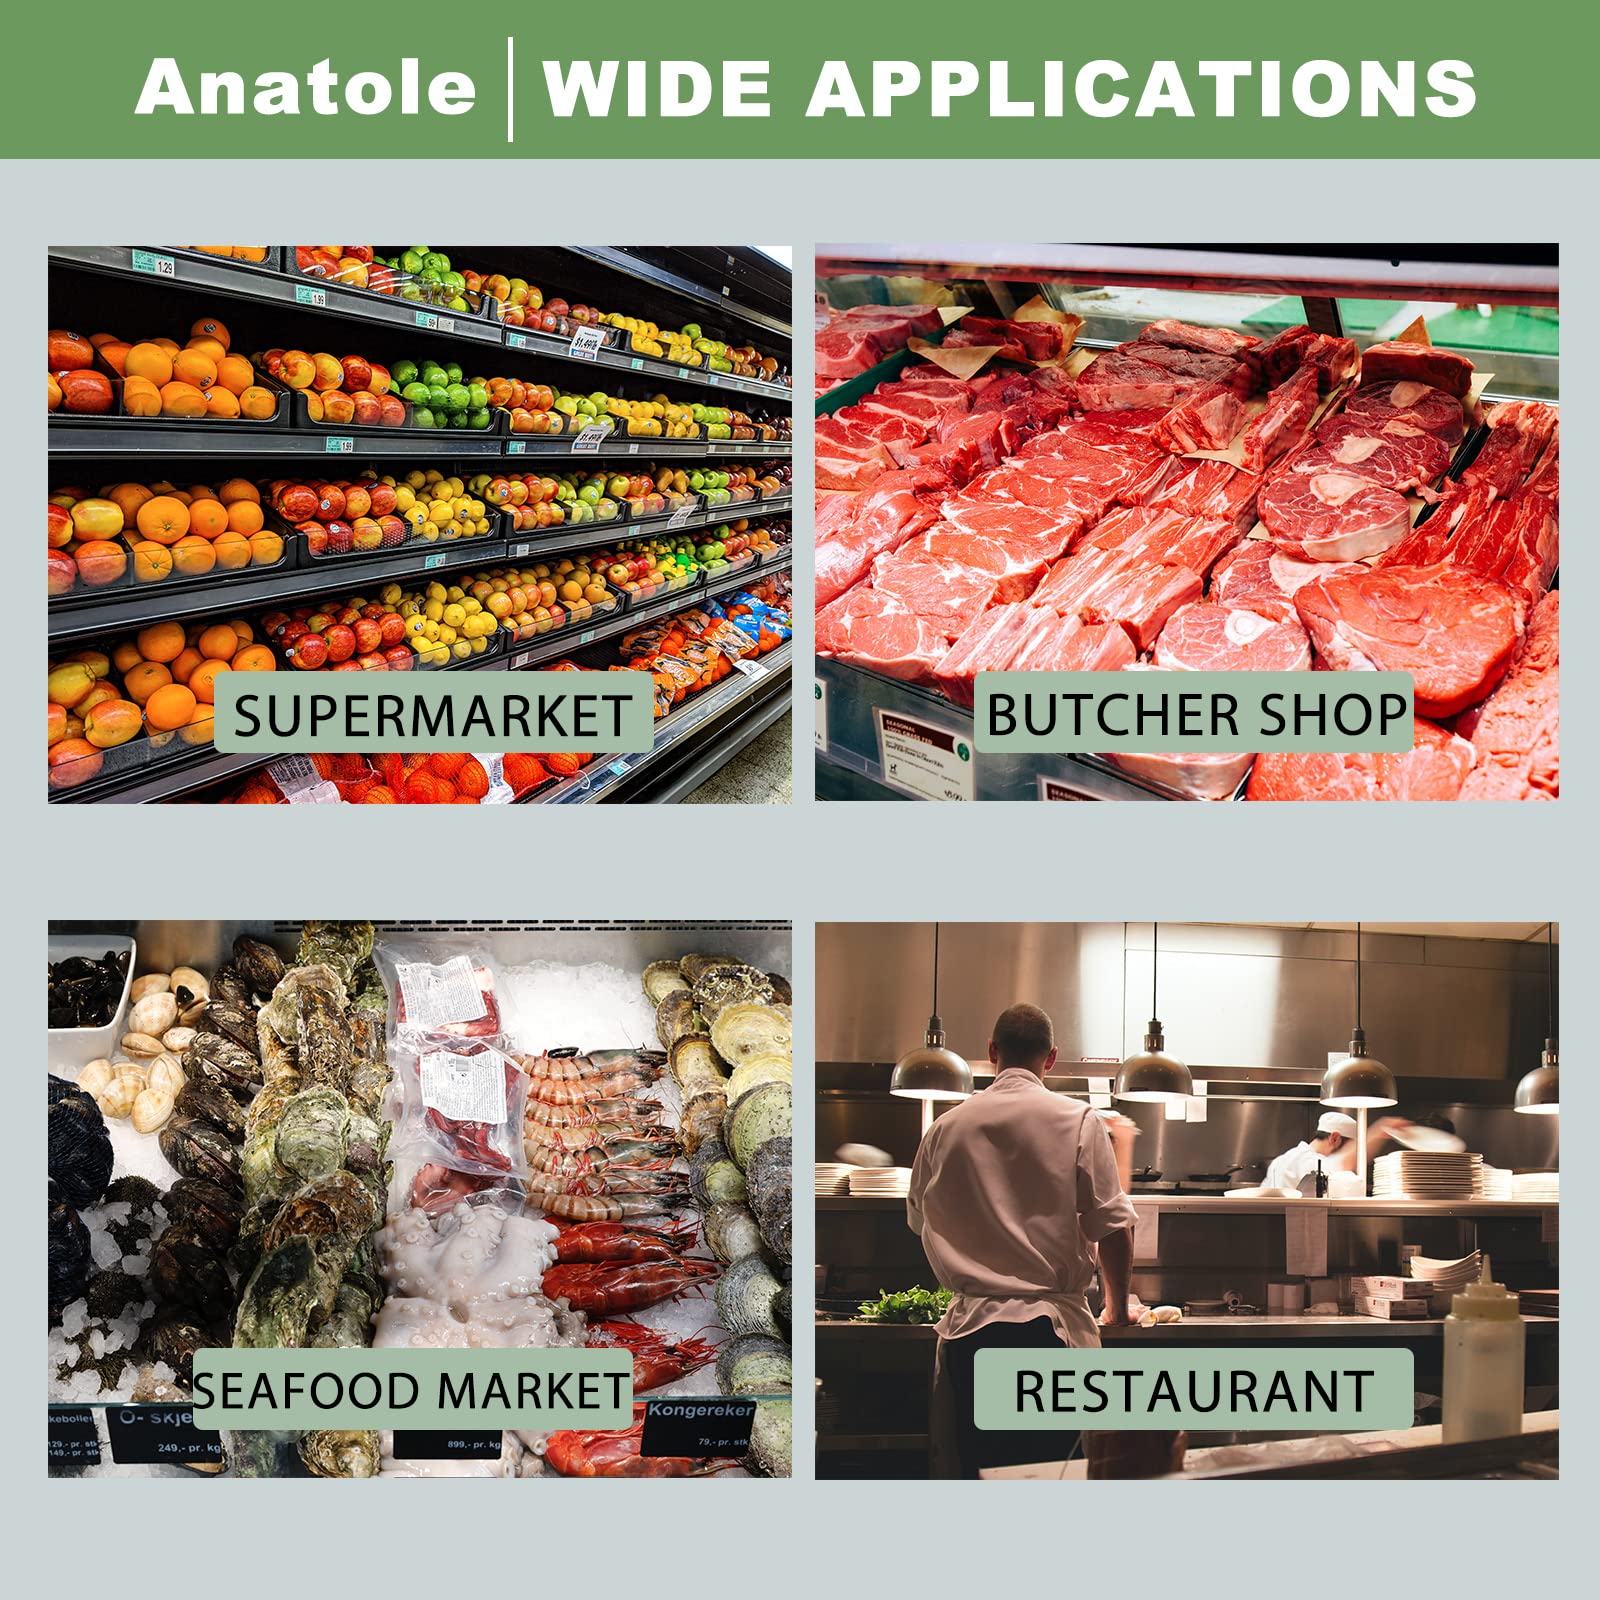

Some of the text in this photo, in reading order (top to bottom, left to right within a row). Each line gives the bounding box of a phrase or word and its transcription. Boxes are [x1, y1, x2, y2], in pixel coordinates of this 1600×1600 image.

[158, 261, 172, 274] 1.29
[313, 294, 324, 305] 1.99
[648, 1403, 755, 1419] Kongereker
[473, 1441, 487, 1450] pr.
[489, 1440, 501, 1450] kg
[718, 1438, 731, 1447] pr.
[734, 1438, 748, 1446] stk
[158, 1443, 221, 1454] 249,- pr. kg
